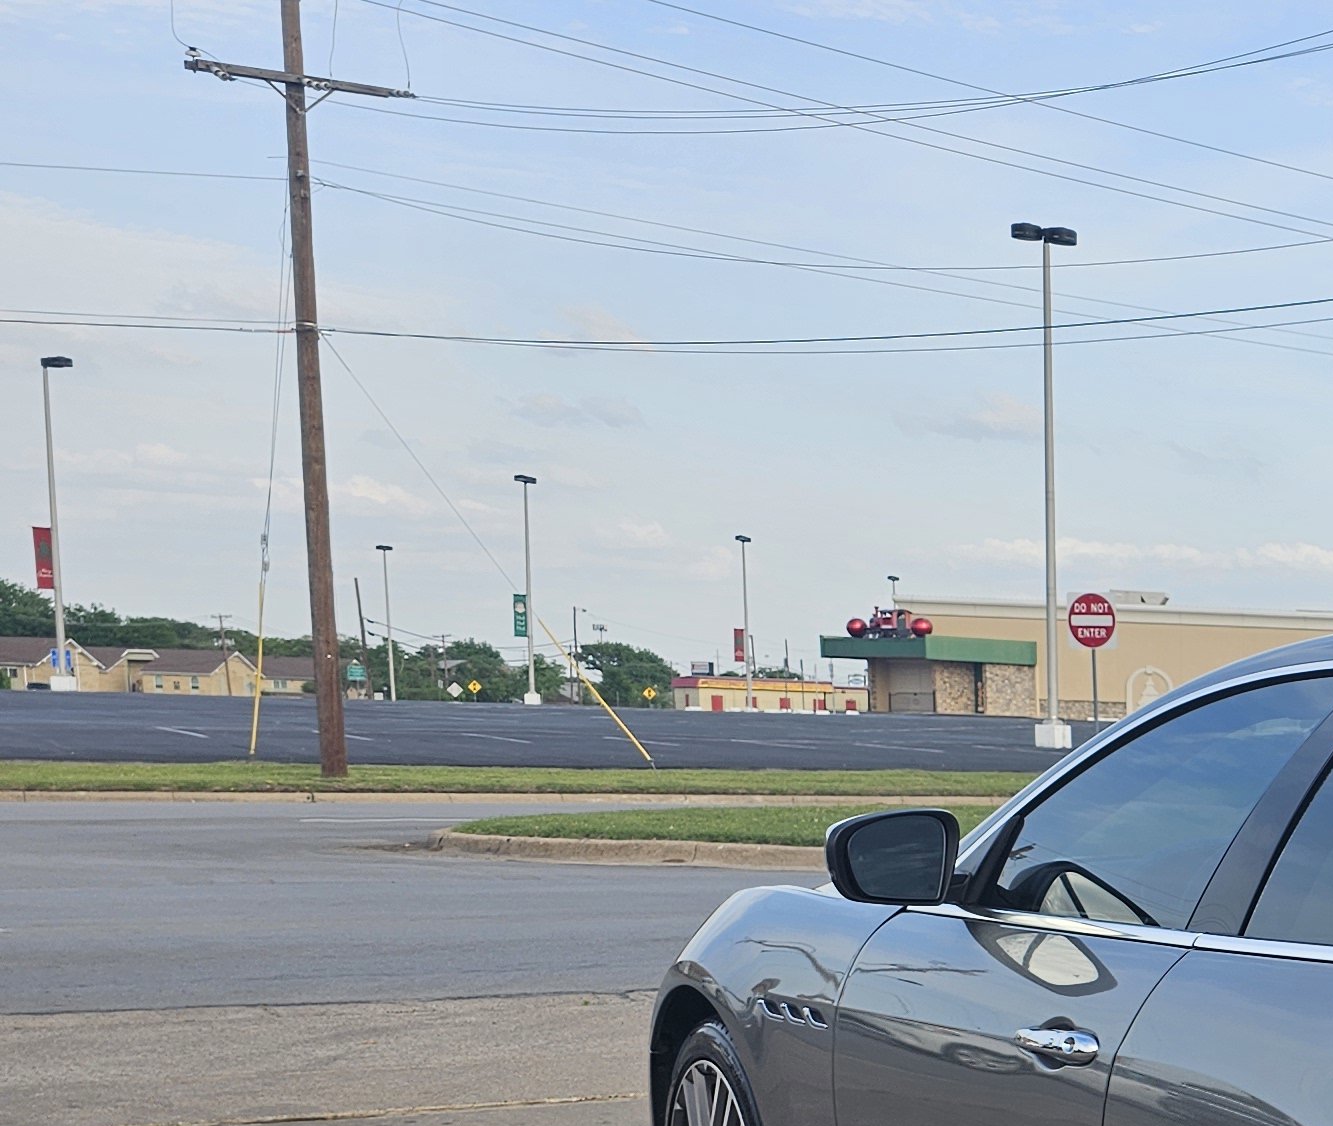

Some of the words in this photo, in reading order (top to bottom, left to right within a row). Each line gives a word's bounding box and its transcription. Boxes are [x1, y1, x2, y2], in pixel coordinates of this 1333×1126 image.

[1073, 602, 1087, 613] DO
[1090, 602, 1109, 613] NOT
[1077, 627, 1107, 639] ENTER
